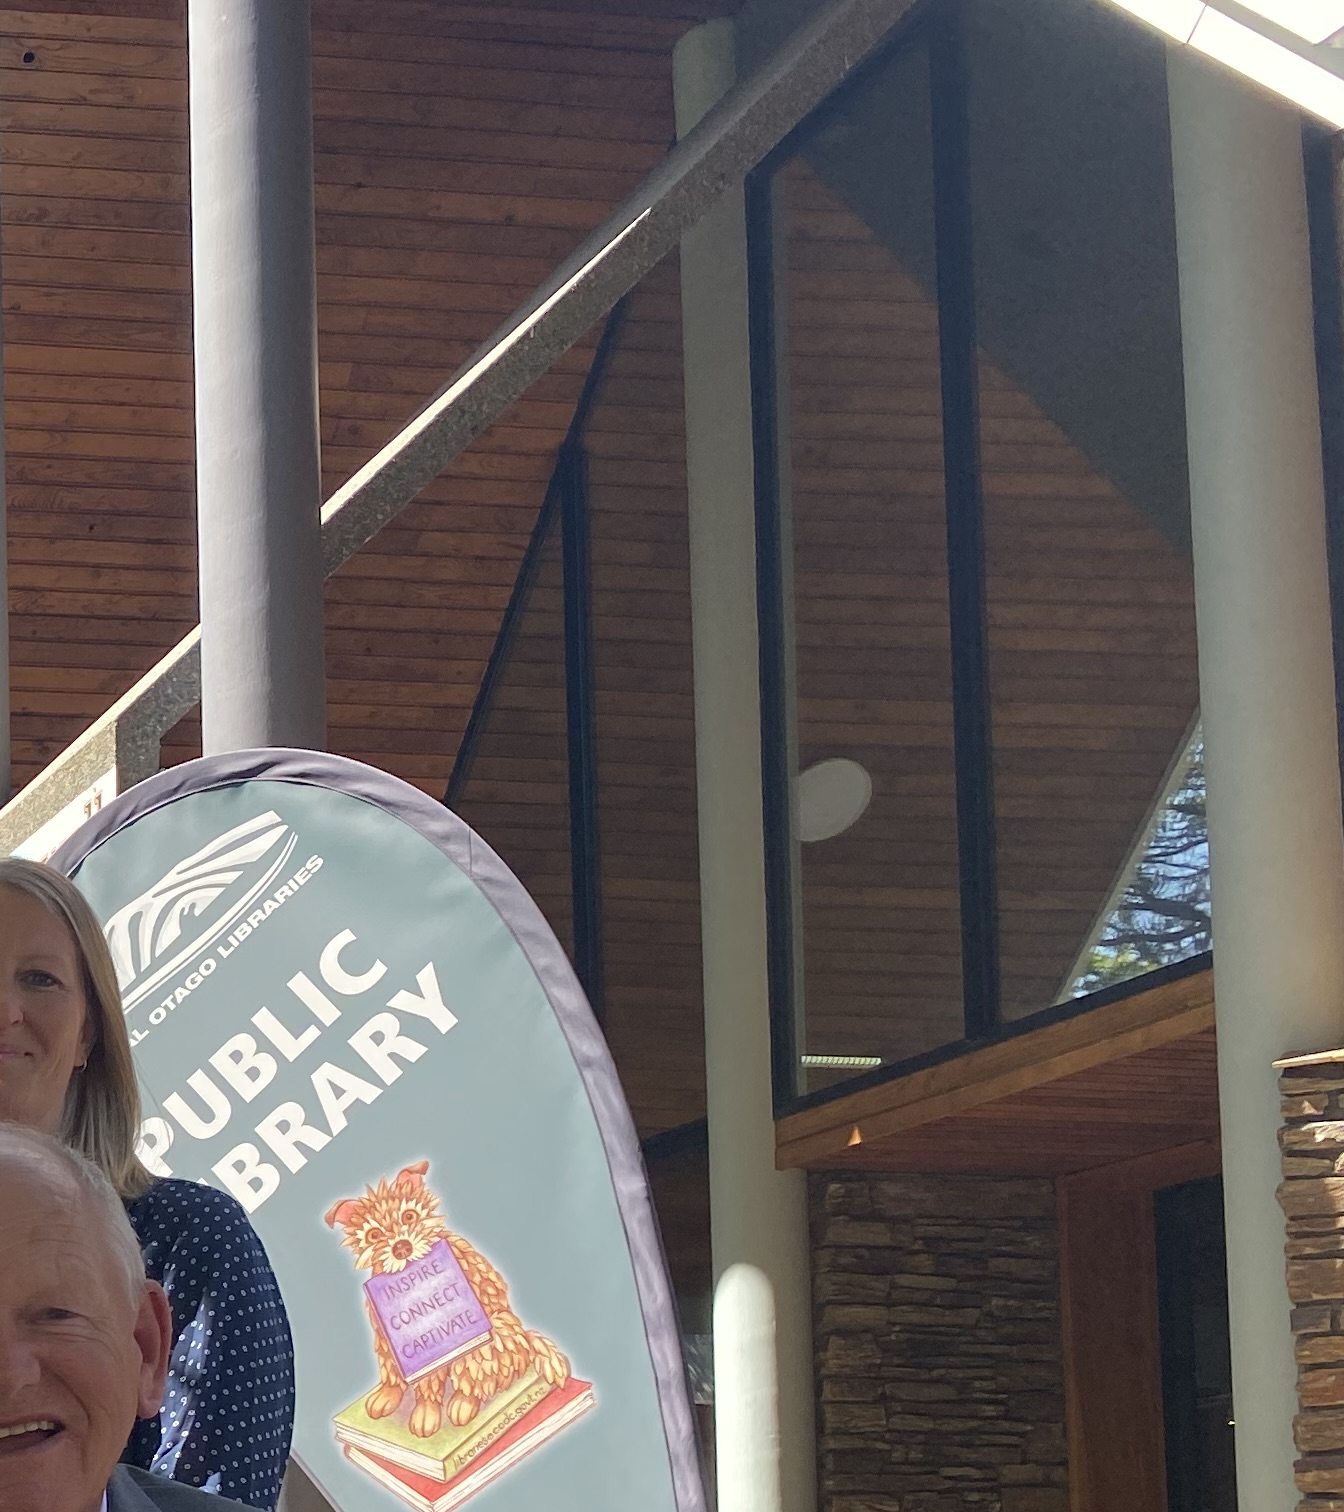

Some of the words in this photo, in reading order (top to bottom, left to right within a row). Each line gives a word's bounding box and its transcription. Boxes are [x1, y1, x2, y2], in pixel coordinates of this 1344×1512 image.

[148, 957, 217, 1025] OTAGO
[216, 854, 324, 959] LIBRARIES
[135, 929, 388, 1177] PUBLIC
[201, 961, 459, 1214] BRARY
[383, 1260, 445, 1301] INSPIRE
[390, 1283, 461, 1331] CONNECT
[402, 1309, 478, 1359] CAPTIVATE
